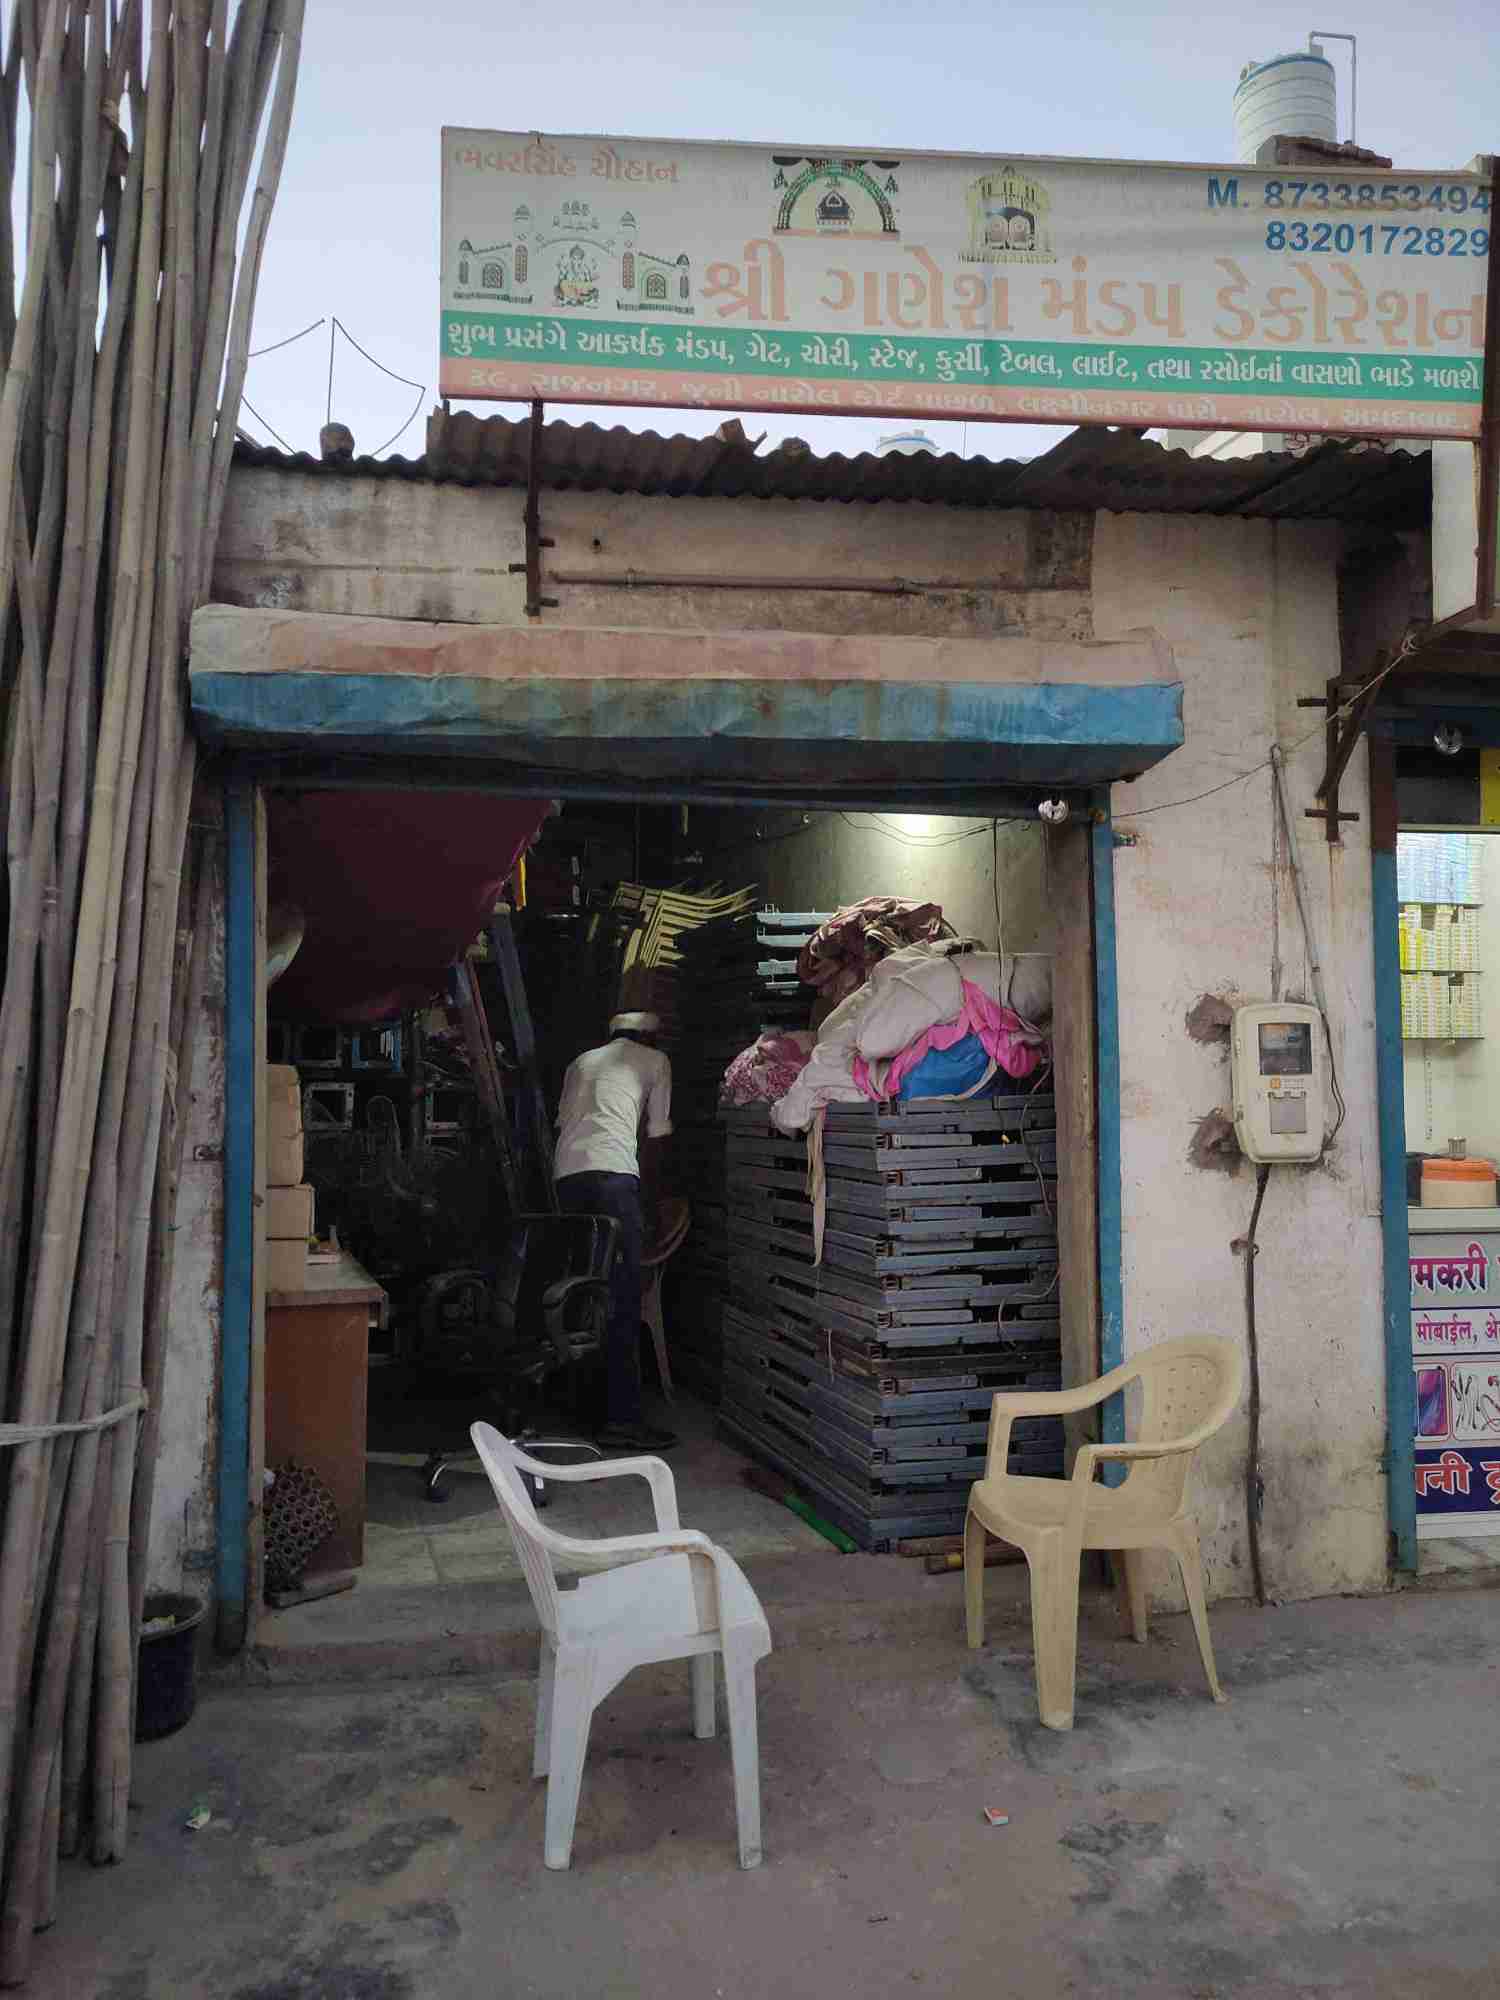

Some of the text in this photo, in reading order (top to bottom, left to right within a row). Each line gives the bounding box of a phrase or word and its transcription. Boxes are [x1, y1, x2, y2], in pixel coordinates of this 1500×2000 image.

[1207, 176, 1489, 214] M. 8733853494
[1265, 221, 1489, 257] 8320172829
[703, 238, 1487, 349] શ્રી ગણેશ મંડપ ડેકોરેશન
[447, 321, 497, 356] શુભ
[503, 321, 567, 351] પ્રસંગે
[575, 327, 665, 357] આકર્ષક
[675, 330, 735, 366] મંડપ,
[744, 331, 791, 369] ગેટ,
[800, 334, 859, 372] ચોરી,
[869, 338, 925, 375] સ્ટેજ,
[999, 343, 1063, 380] ટેબલ,
[1146, 358, 1193, 380] તથા
[1290, 356, 1364, 386] વાસણો
[1369, 357, 1415, 388] ભાડે
[1423, 360, 1481, 391] મળશે
